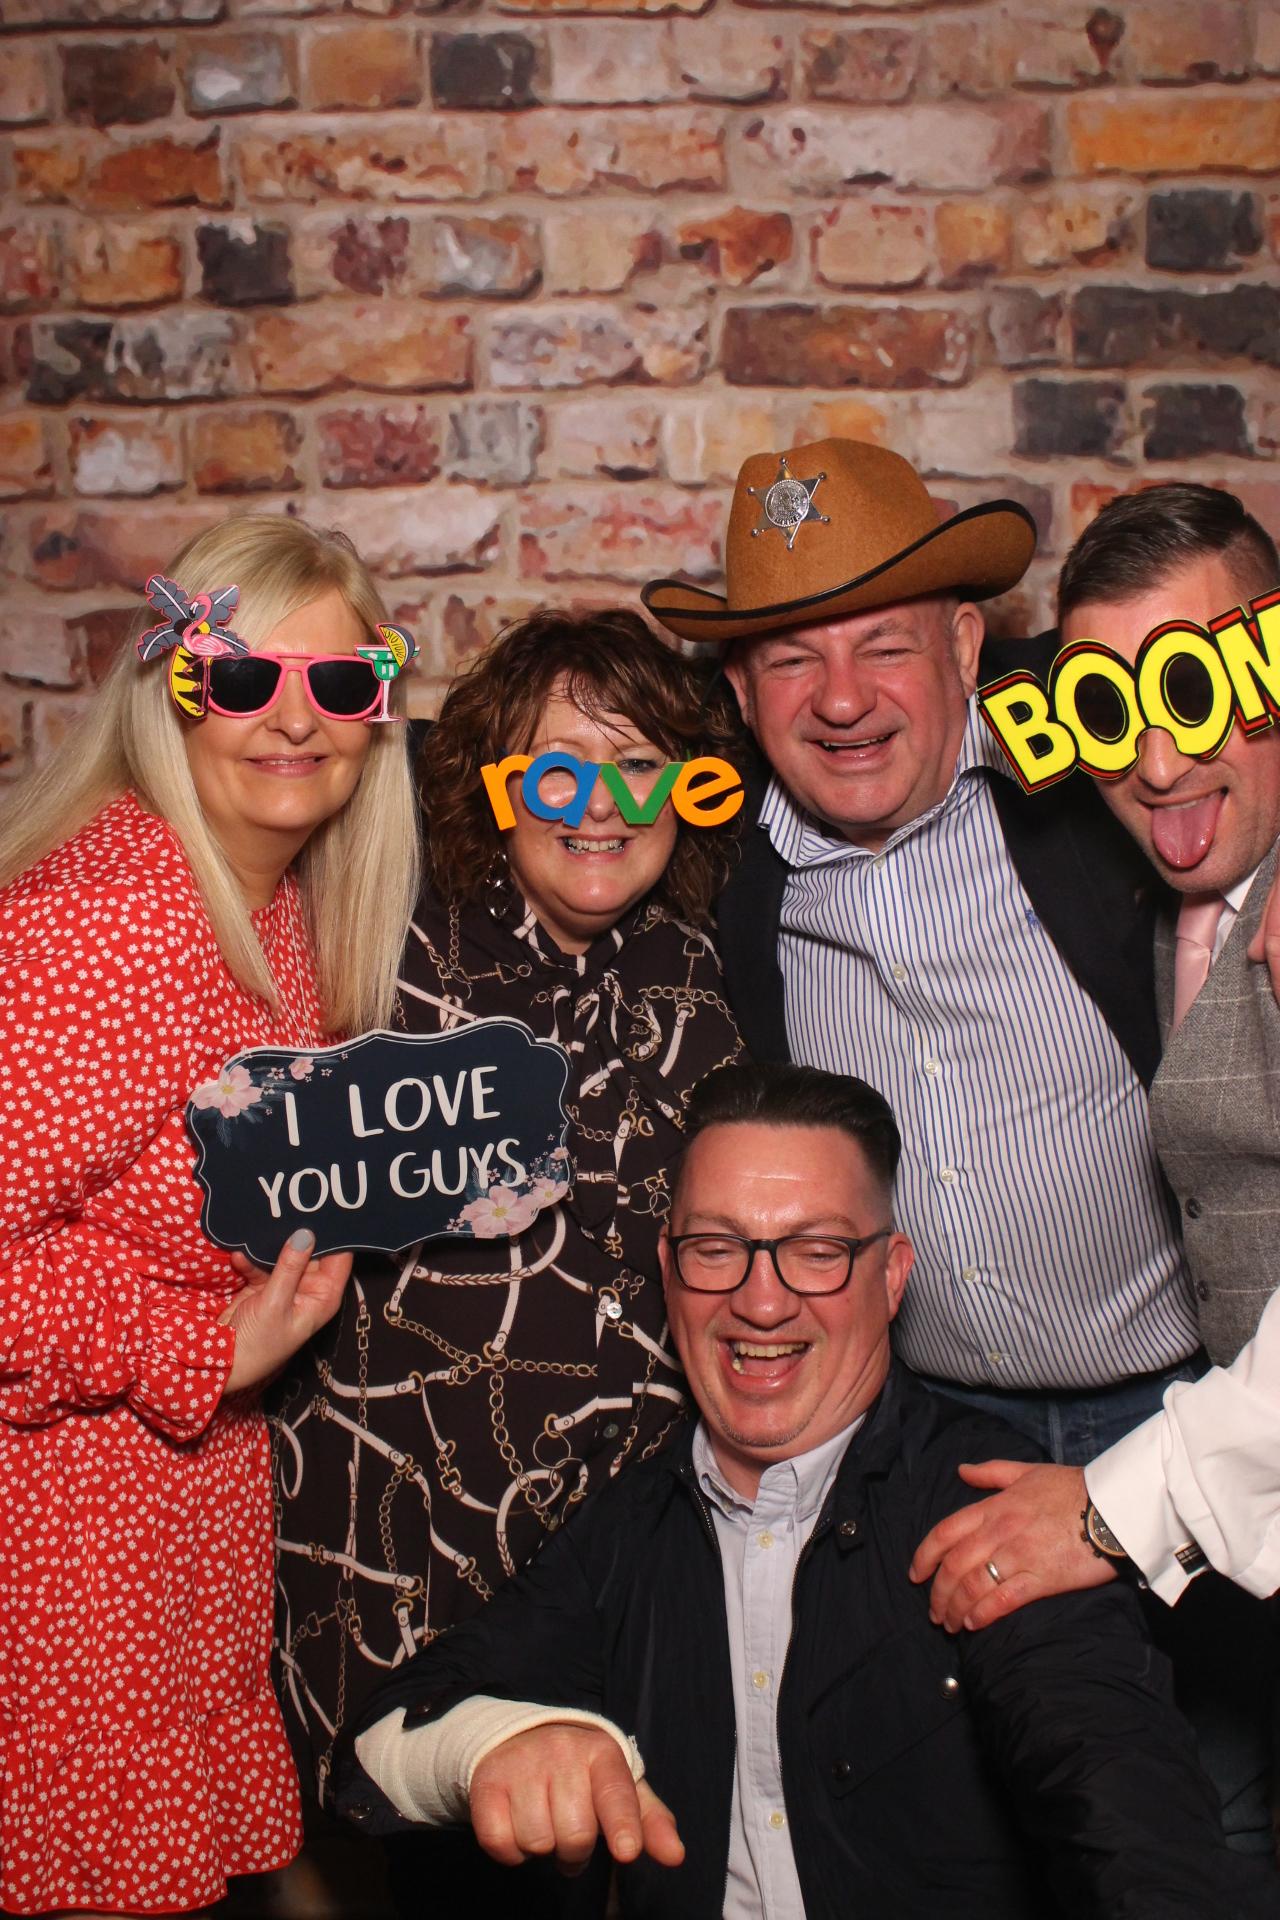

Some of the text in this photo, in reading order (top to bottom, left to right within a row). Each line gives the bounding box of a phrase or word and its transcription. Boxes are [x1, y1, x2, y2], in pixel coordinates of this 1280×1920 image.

[480, 751, 745, 830] rave
[285, 1065, 500, 1147] I LOVE
[257, 1137, 525, 1218] YOU GUYS
